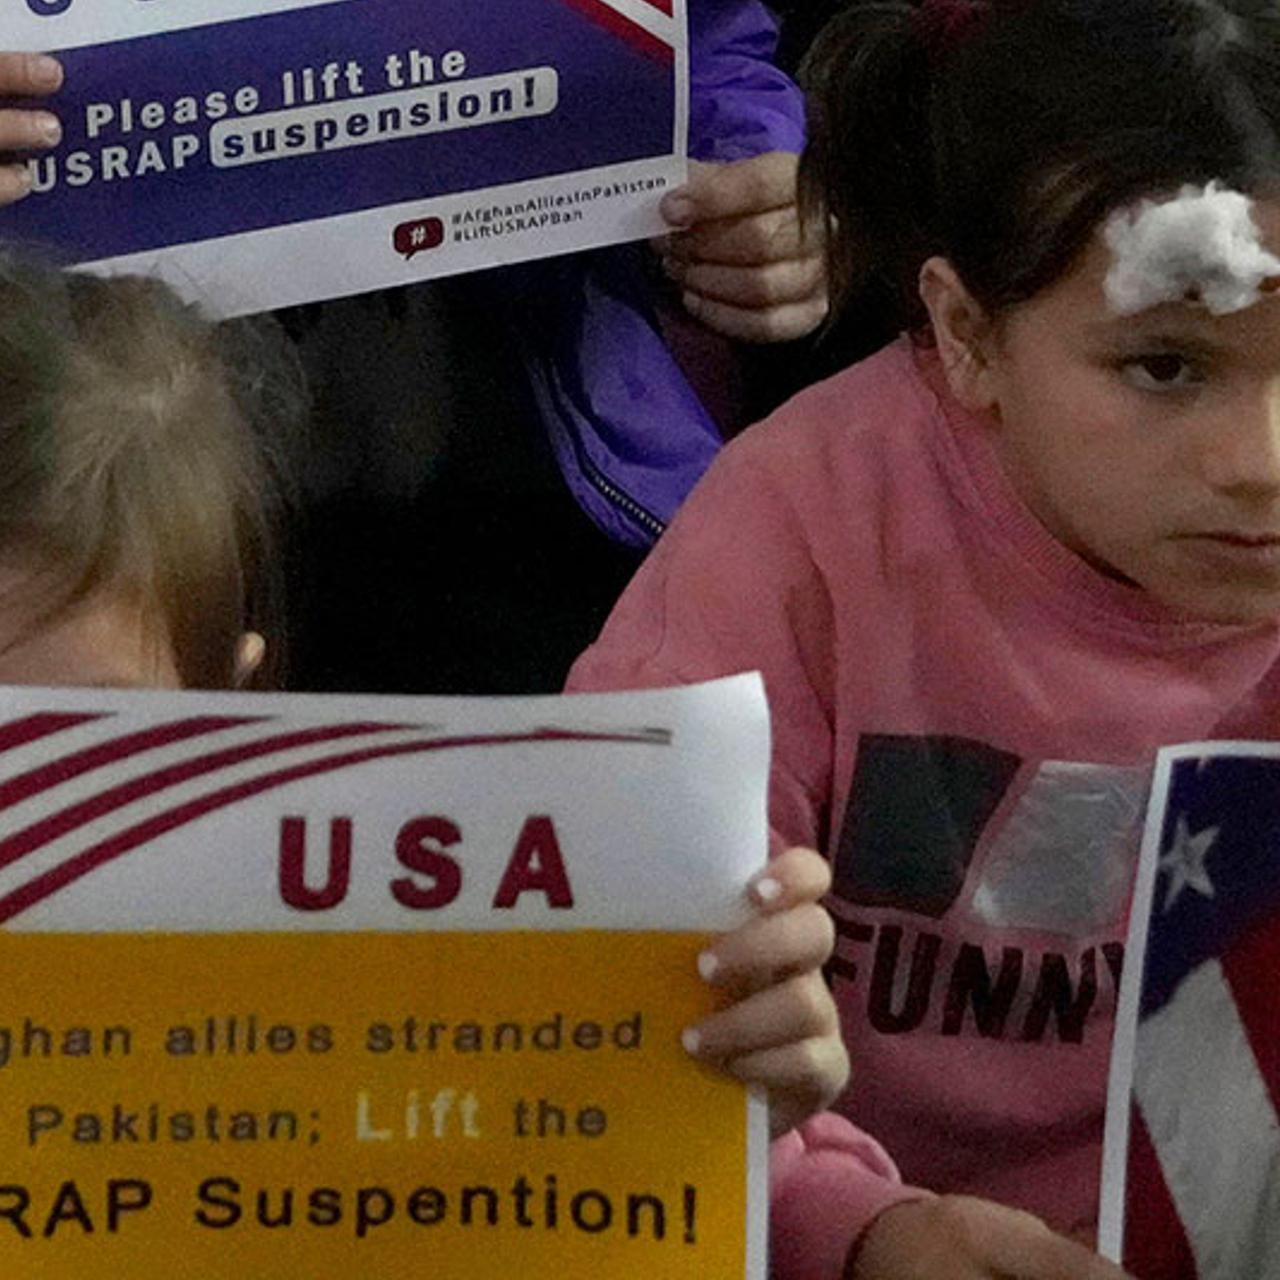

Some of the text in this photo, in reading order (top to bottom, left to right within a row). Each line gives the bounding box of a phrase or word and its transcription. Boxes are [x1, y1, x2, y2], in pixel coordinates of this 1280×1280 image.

[87, 50, 465, 138] Please lift the
[27, 76, 537, 193] USRAP suspension!
[165, 1016, 334, 1056] allies
[367, 1011, 642, 1053] stranded
[28, 1088, 480, 1146] Pakistan; Lift
[195, 1175, 695, 1243] Suspention!
